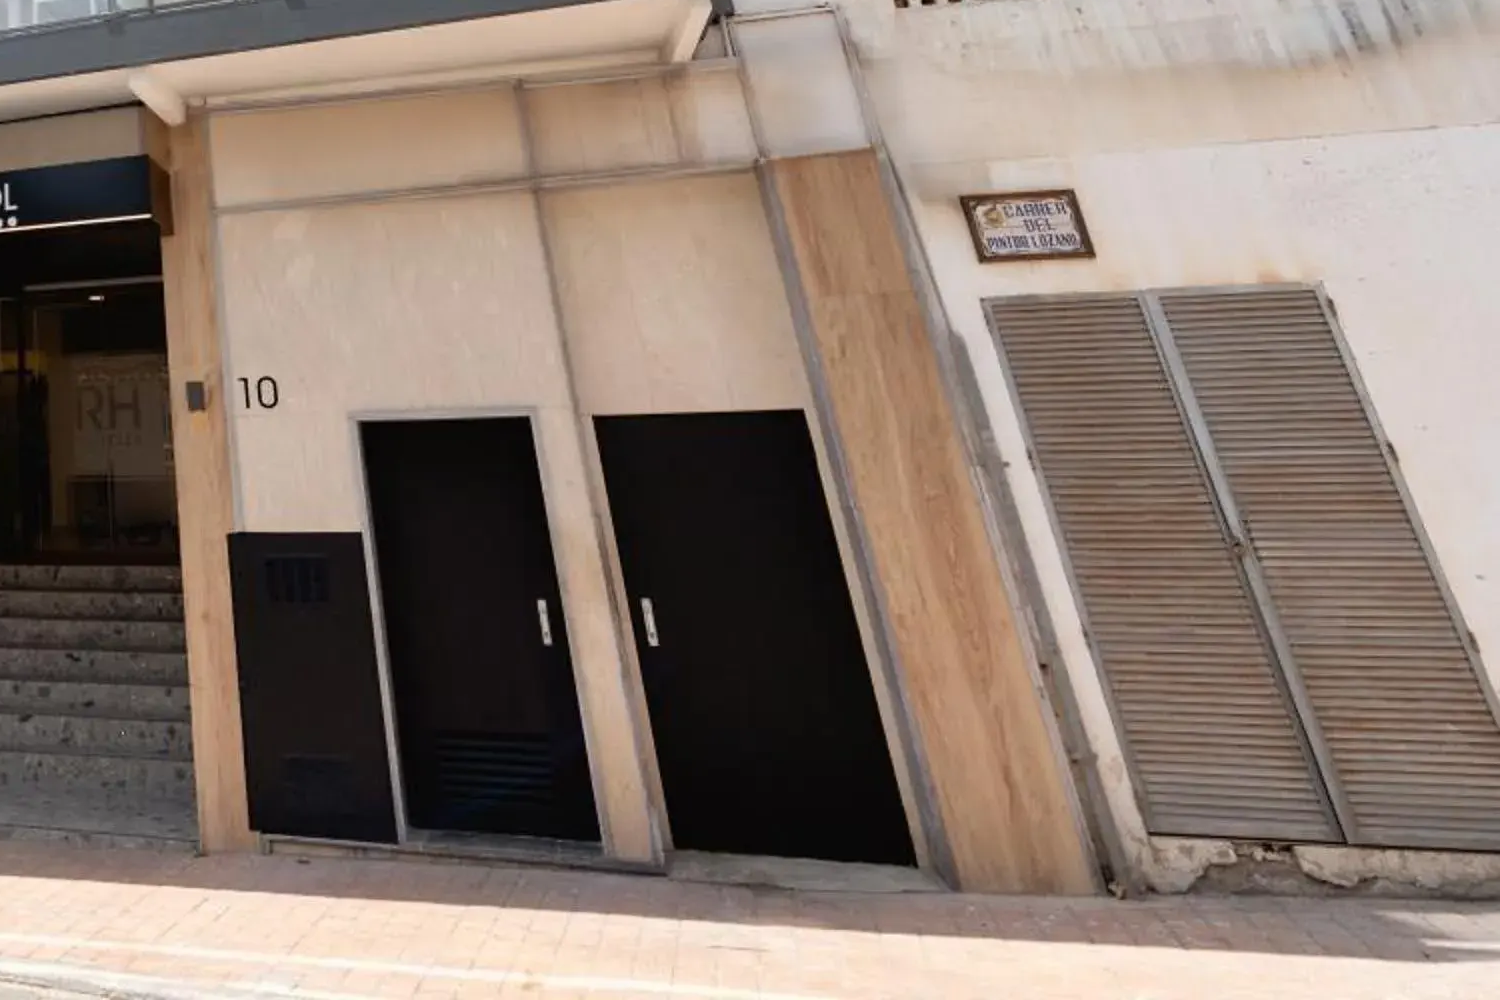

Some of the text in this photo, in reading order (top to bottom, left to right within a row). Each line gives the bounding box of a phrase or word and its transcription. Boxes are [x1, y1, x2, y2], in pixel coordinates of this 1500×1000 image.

[1003, 202, 1068, 217] CARRER
[1022, 218, 1056, 232] DEL
[237, 376, 279, 409] 10
[77, 386, 142, 431] RH
